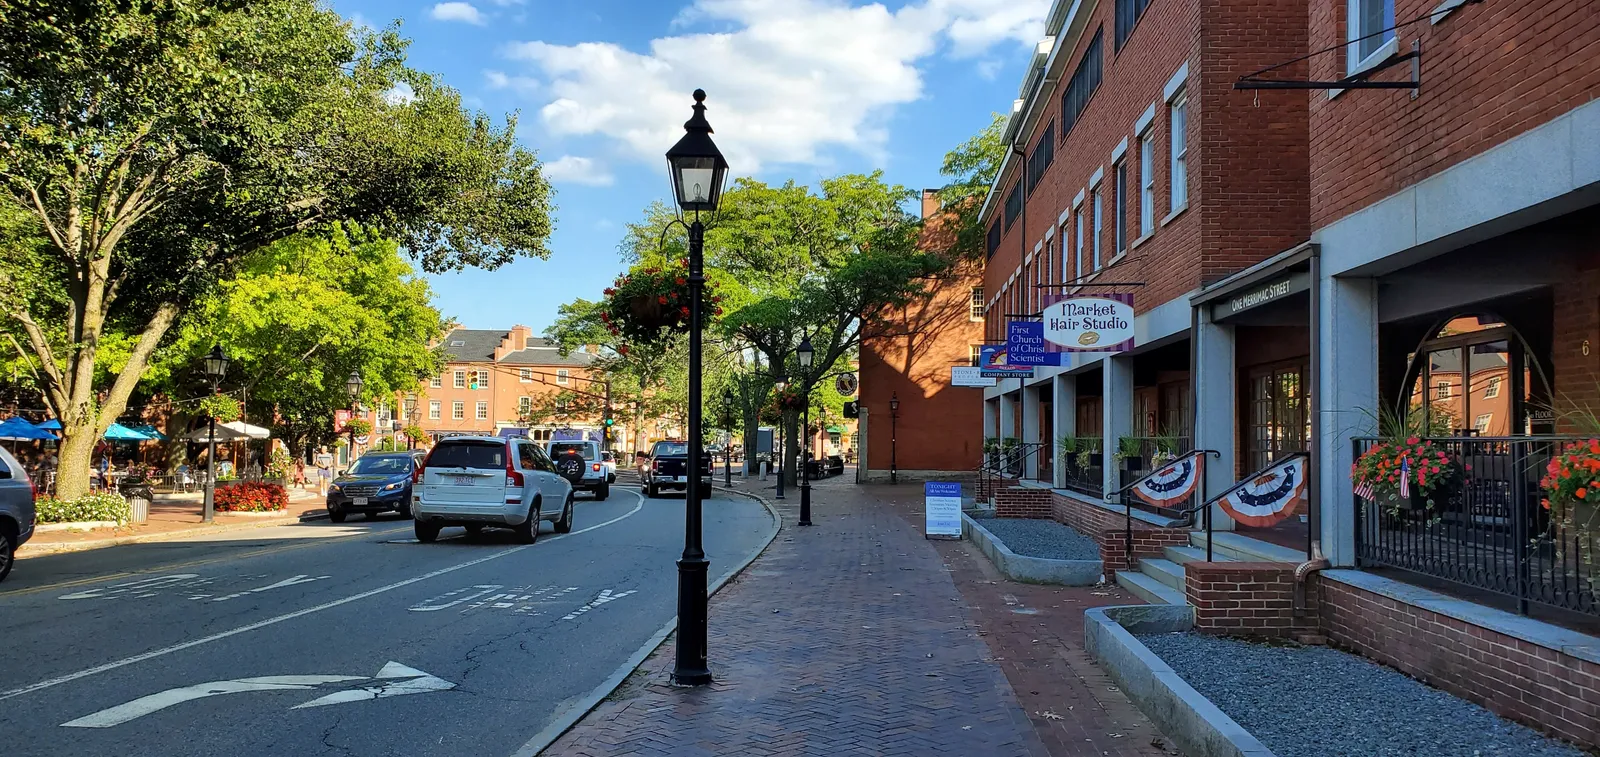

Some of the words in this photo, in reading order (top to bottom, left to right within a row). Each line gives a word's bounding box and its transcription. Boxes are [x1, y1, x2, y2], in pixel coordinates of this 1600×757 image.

[1231, 298, 1243, 311] ONE
[1242, 288, 1269, 307] MERRIMAC
[1269, 280, 1290, 298] STREET
[1062, 303, 1116, 316] Market
[1011, 325, 1030, 334] First
[1050, 318, 1079, 331] Hair
[1082, 317, 1128, 330] Studio
[1011, 335, 1042, 344] Church
[1010, 344, 1020, 353] of
[1582, 340, 1590, 356] 6
[1010, 353, 1045, 362] Scientist
